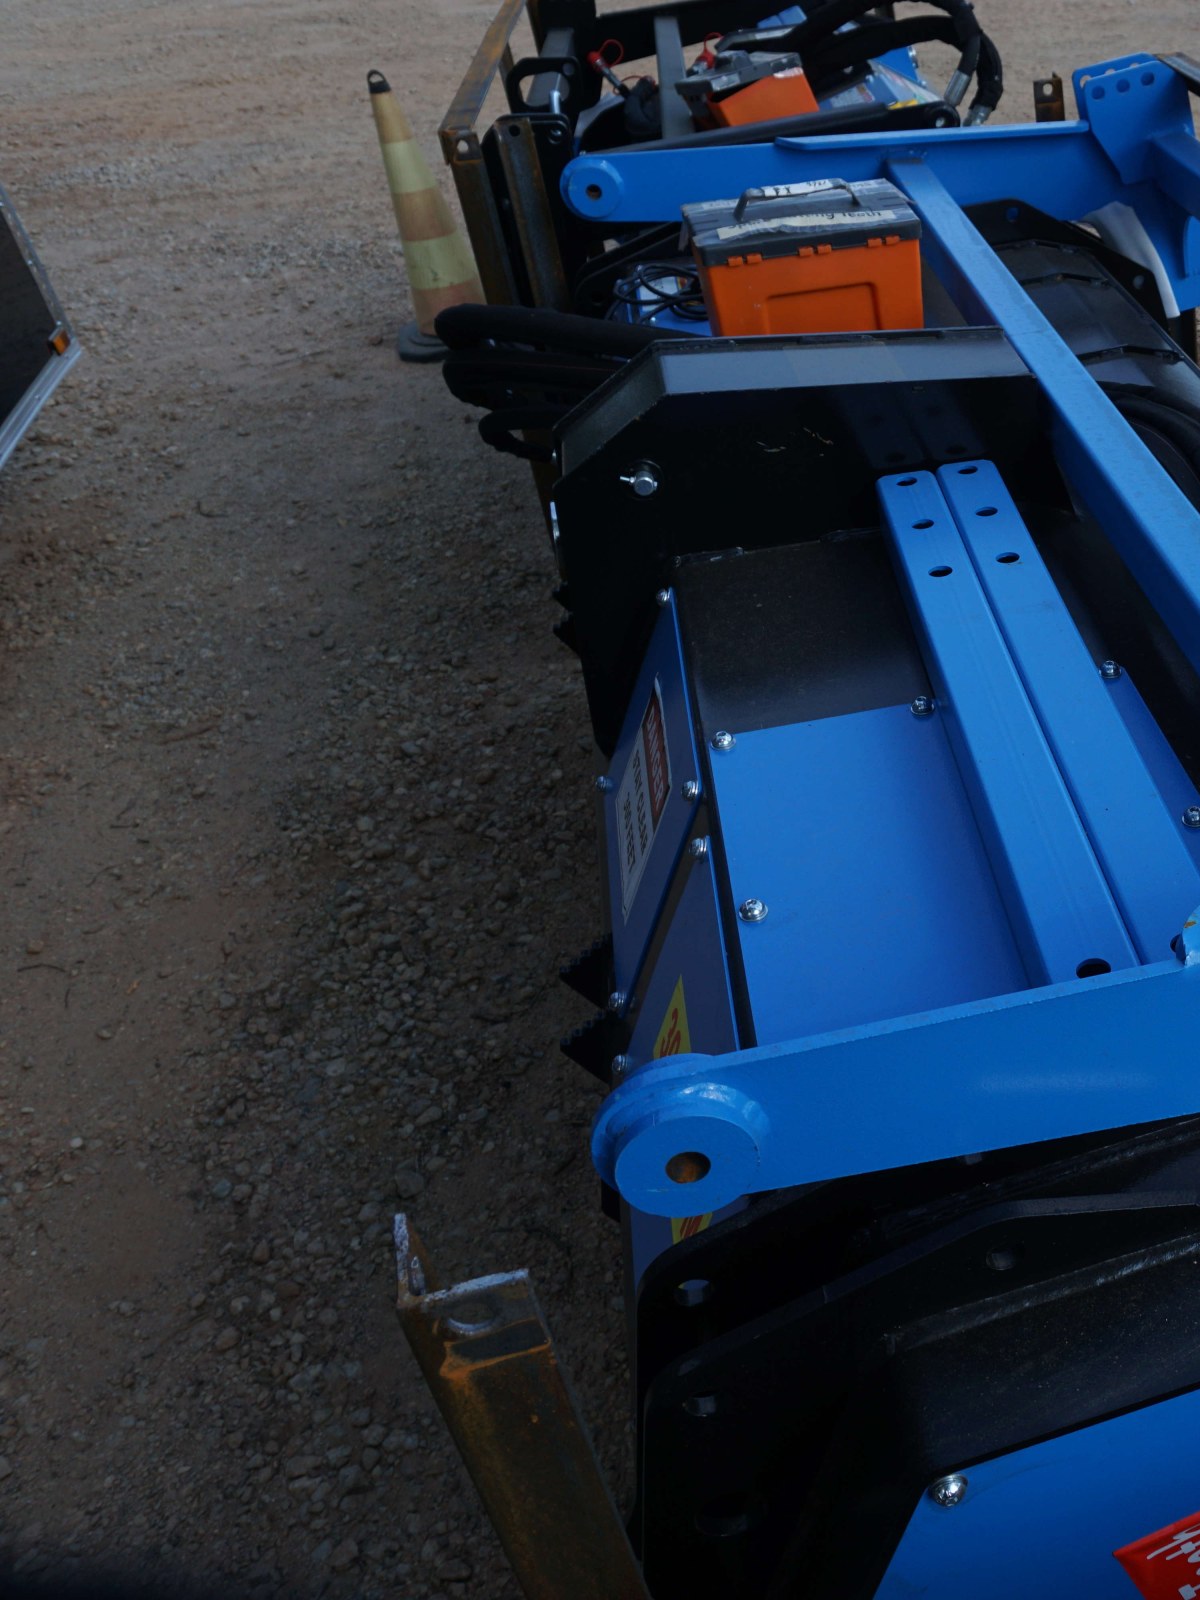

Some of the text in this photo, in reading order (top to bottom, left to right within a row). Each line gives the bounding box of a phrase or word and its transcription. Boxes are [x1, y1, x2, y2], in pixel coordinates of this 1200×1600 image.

[632, 749, 648, 857] STAY CLEAR
[646, 704, 664, 811] DANGER
